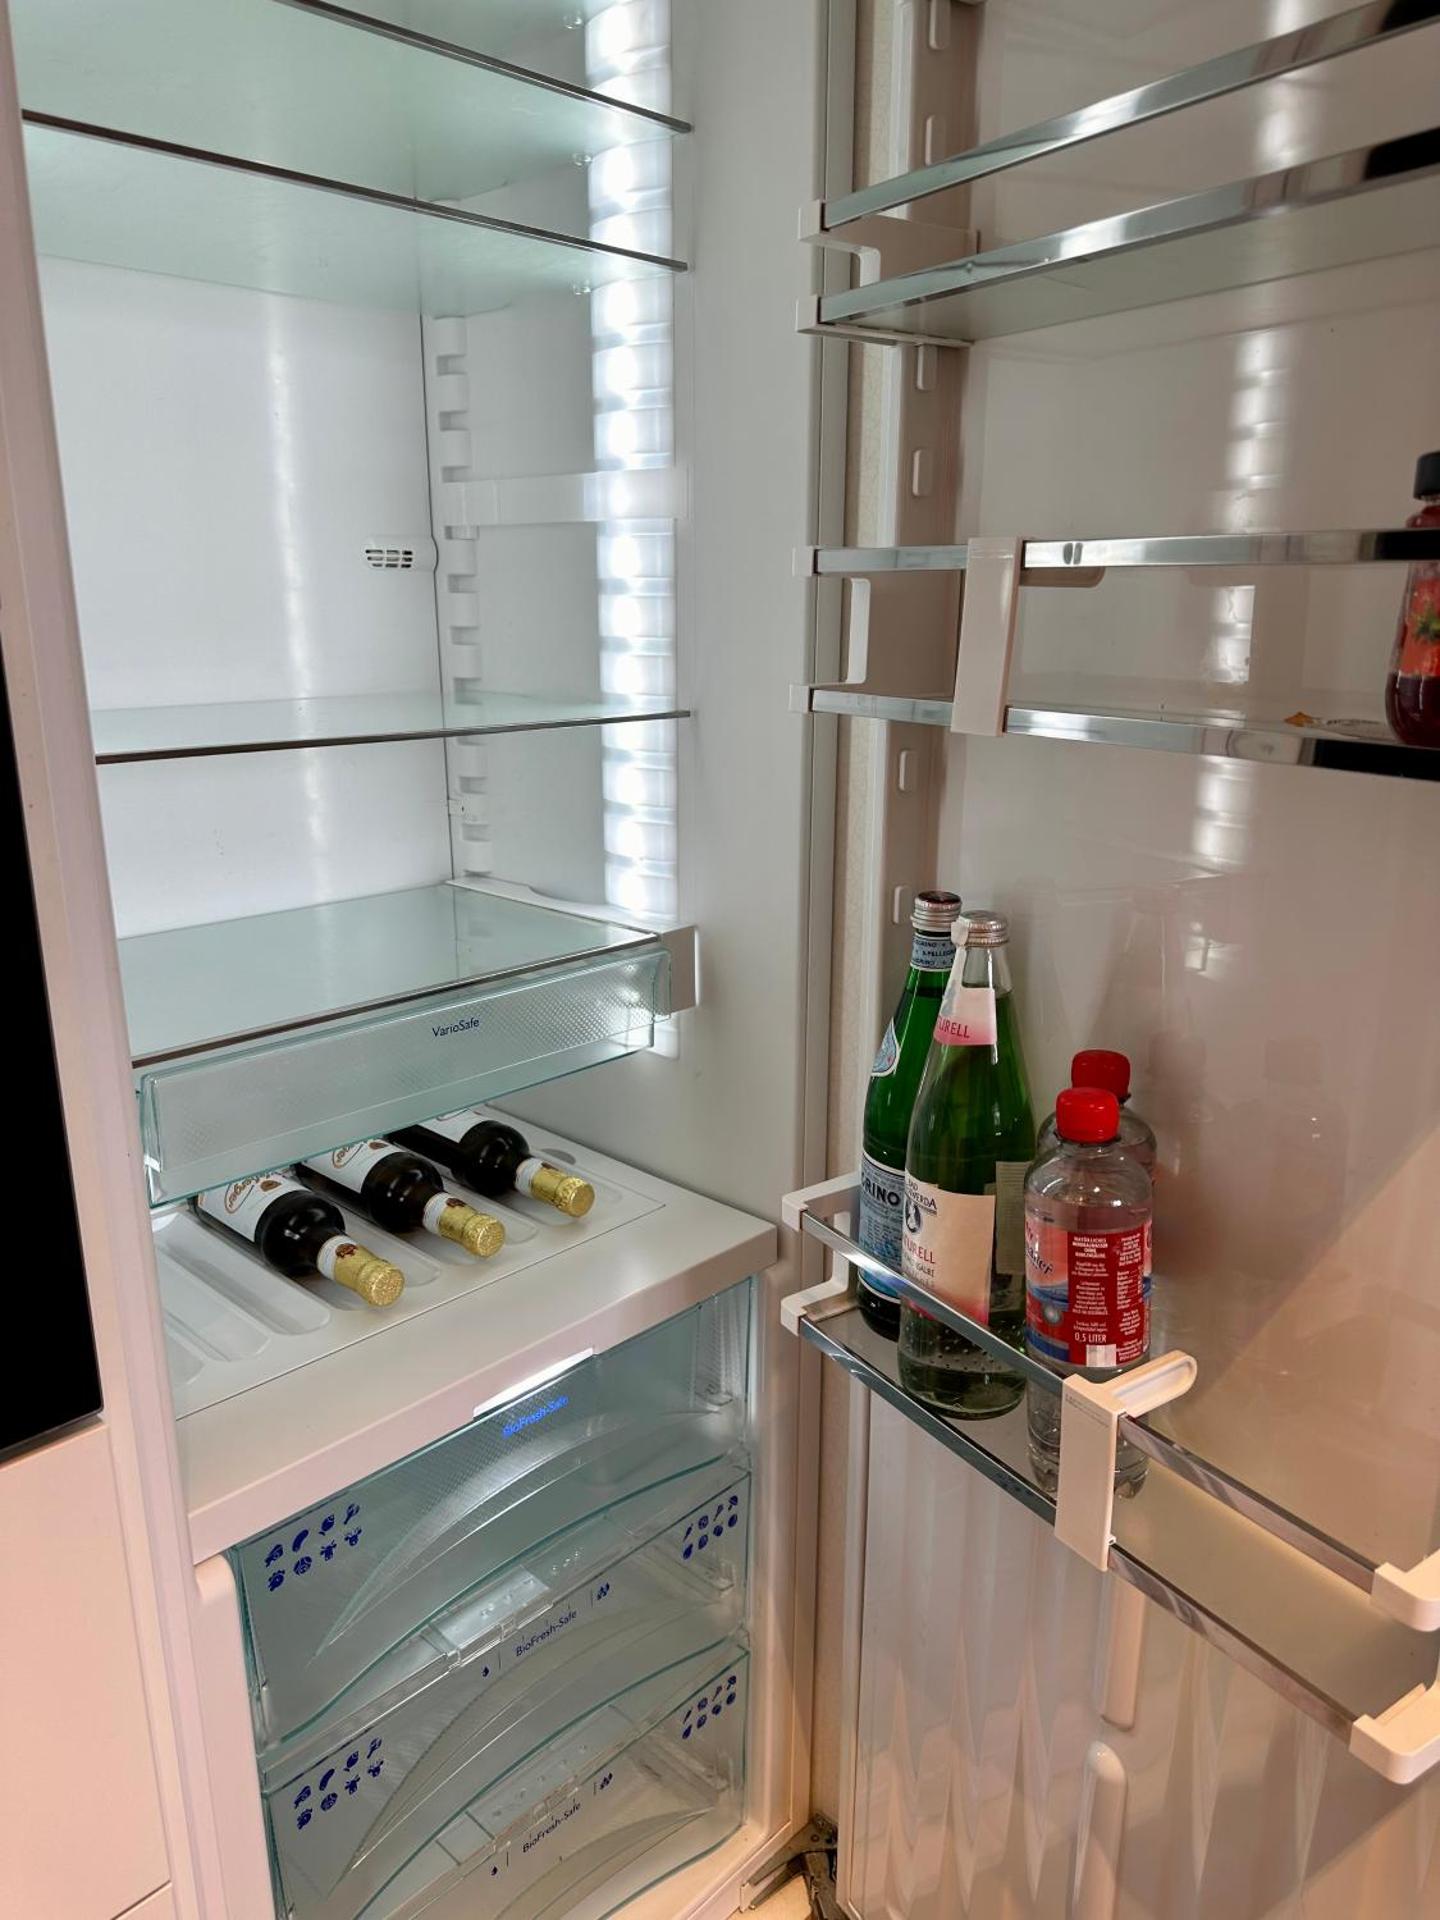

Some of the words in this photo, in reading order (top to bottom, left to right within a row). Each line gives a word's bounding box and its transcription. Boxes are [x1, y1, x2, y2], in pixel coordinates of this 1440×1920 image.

[432, 1017, 480, 1037] VarioSafe
[862, 1174, 901, 1207] RINO
[1088, 1333, 1107, 1344] LITER
[515, 1609, 578, 1658] BioFresh-Safe
[522, 1801, 581, 1854] BioFresh-Safe
